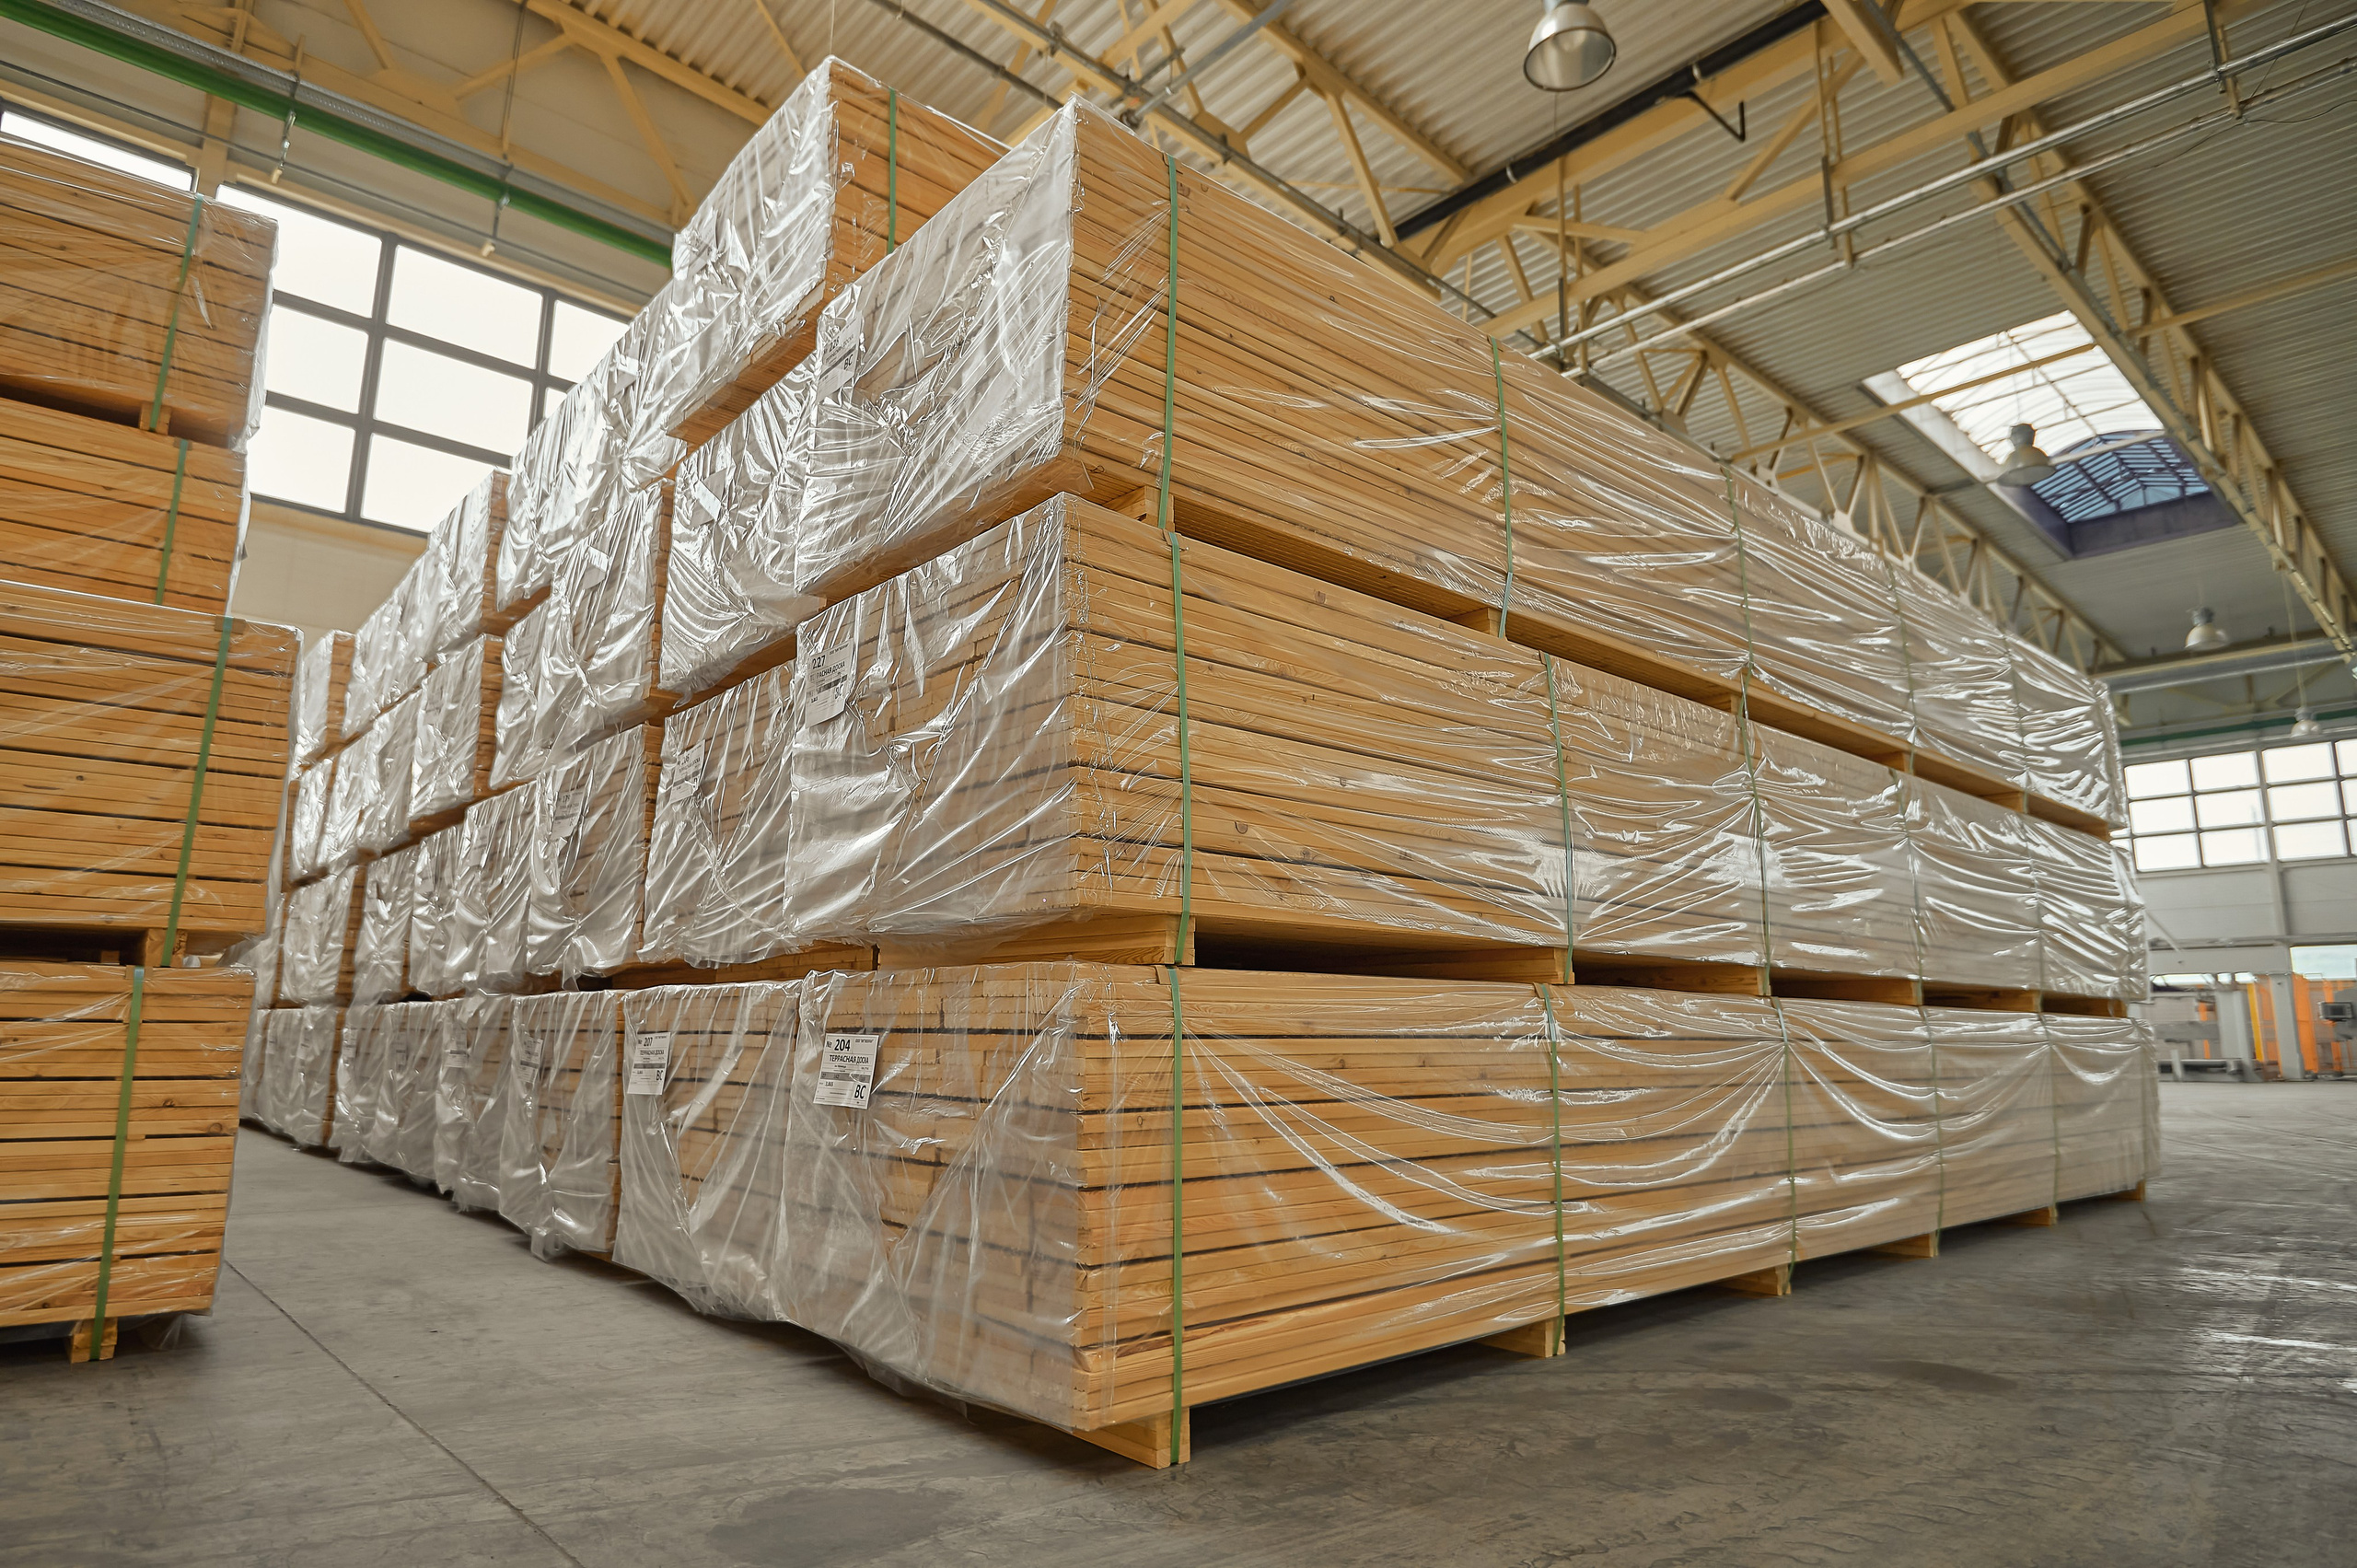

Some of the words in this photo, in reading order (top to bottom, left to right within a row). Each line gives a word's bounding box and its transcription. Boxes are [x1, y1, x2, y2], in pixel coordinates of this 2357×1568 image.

[812, 655, 826, 669] 227
[834, 1039, 851, 1051] 204
[829, 1054, 856, 1063] ТЕРРАСНАЯ
[856, 1056, 869, 1065] ДОСКА
